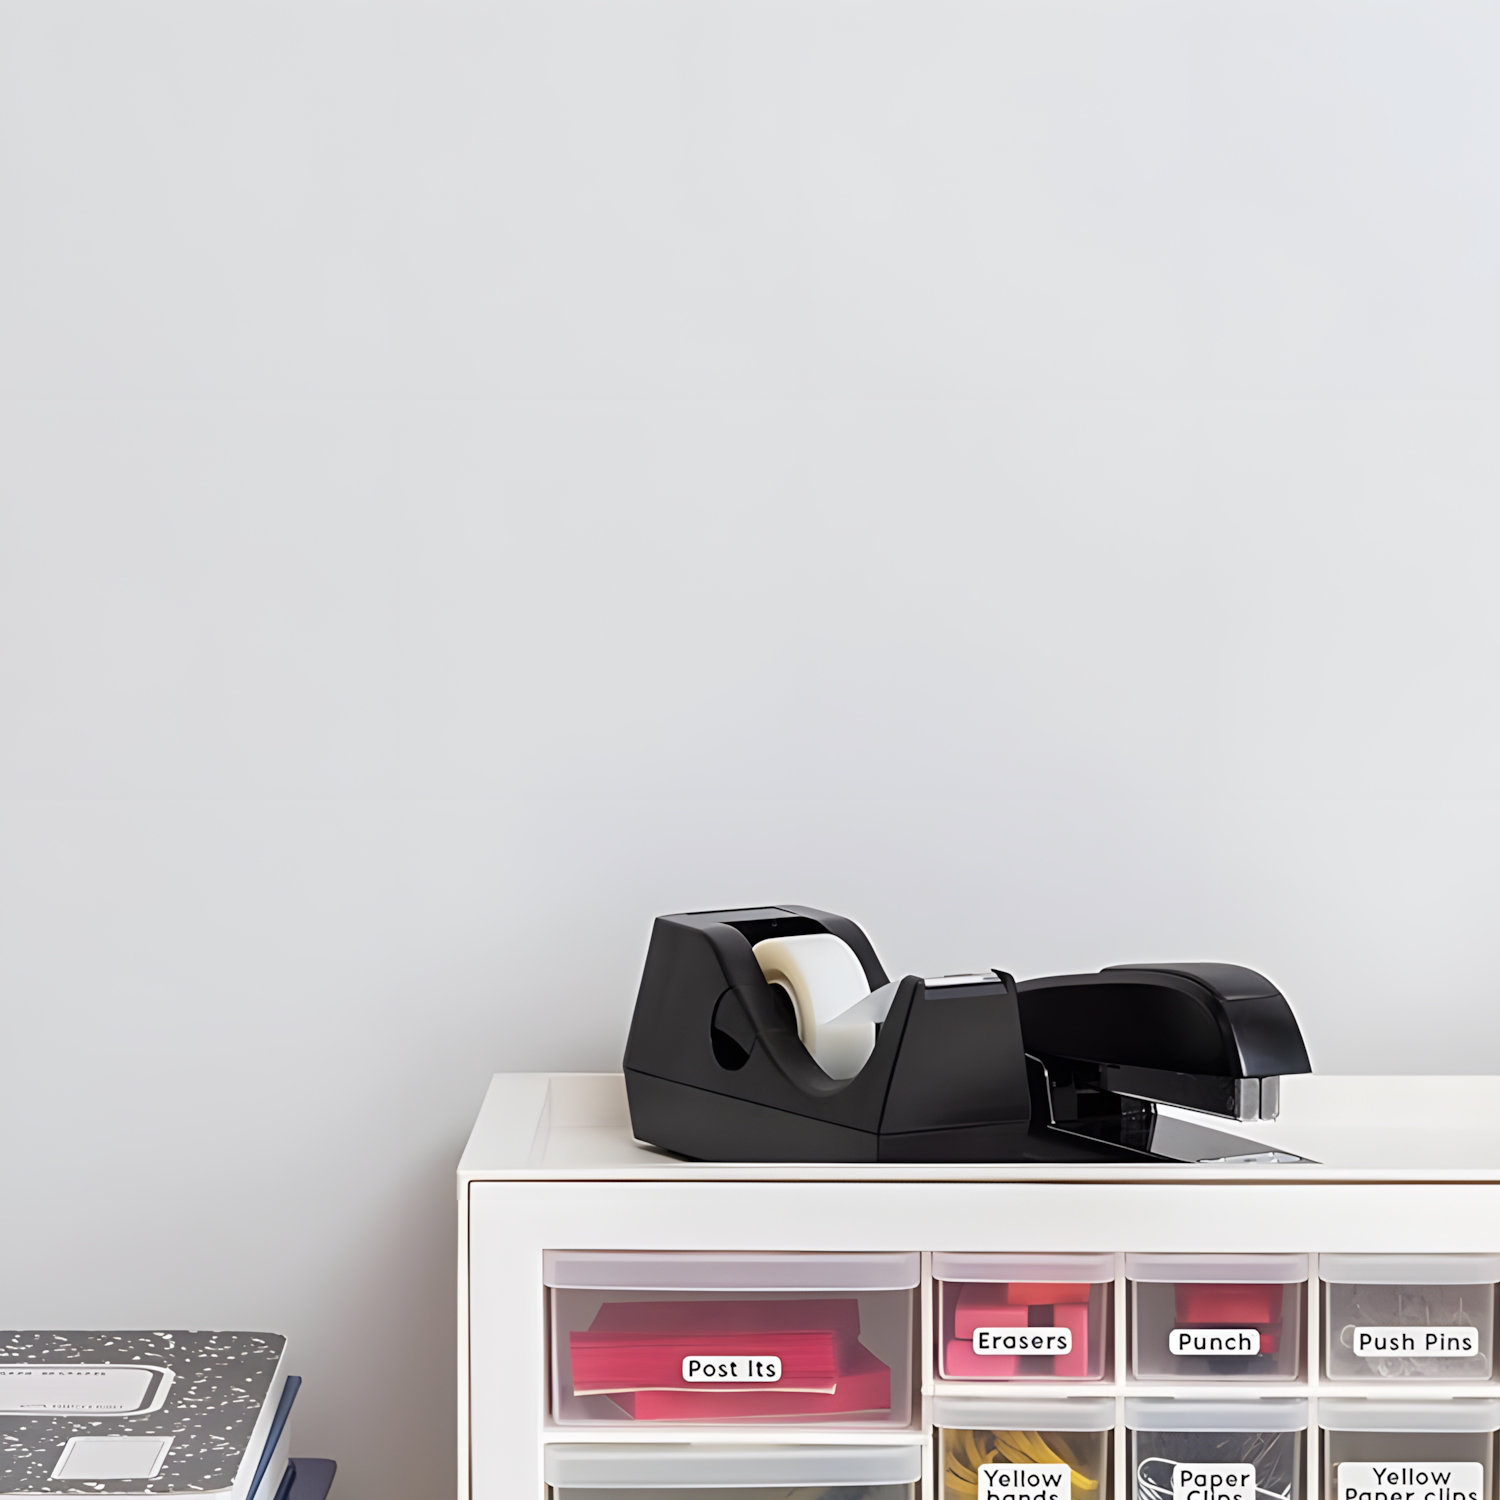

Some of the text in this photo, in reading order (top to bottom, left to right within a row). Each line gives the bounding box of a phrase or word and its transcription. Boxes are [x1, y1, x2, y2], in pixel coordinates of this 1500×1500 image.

[979, 1332, 1067, 1350] Erasers
[1179, 1333, 1251, 1351] Punch
[1360, 1333, 1472, 1351] Push Pins
[689, 1359, 776, 1378] Post Its
[983, 1469, 1062, 1488] Yellow
[1180, 1470, 1250, 1493] Paper
[1372, 1467, 1451, 1486] Yellow
